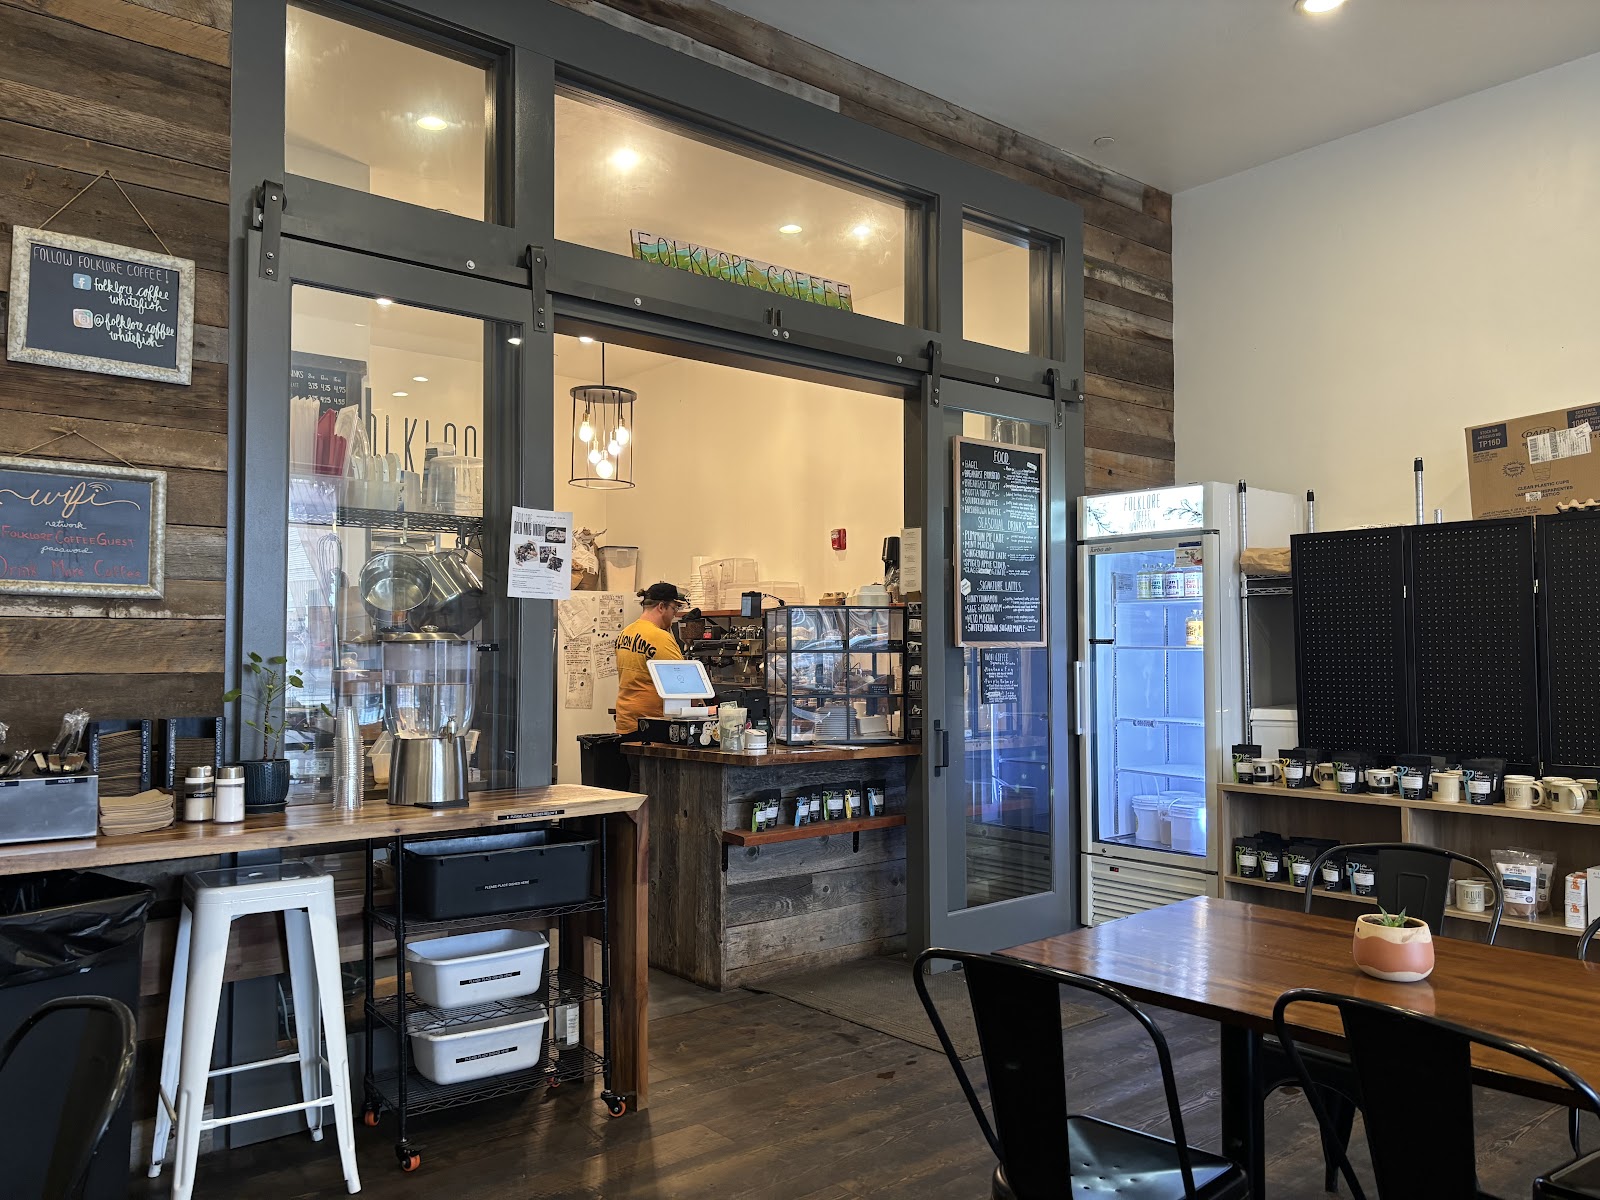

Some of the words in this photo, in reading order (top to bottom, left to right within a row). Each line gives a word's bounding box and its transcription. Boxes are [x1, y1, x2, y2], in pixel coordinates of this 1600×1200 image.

[34, 246, 73, 266] FOLLOW
[78, 255, 123, 276] FOLKLORE
[638, 231, 754, 287] FOLKLORE
[766, 265, 848, 310] COFFEE
[94, 277, 133, 296] folklore
[136, 285, 169, 300] coffee
[108, 294, 167, 314] whitefish
[109, 331, 163, 349] whitefish
[1124, 493, 1160, 511] FOLKLORE
[45, 520, 87, 529] network
[41, 545, 93, 554] password
[632, 633, 656, 660] KING
